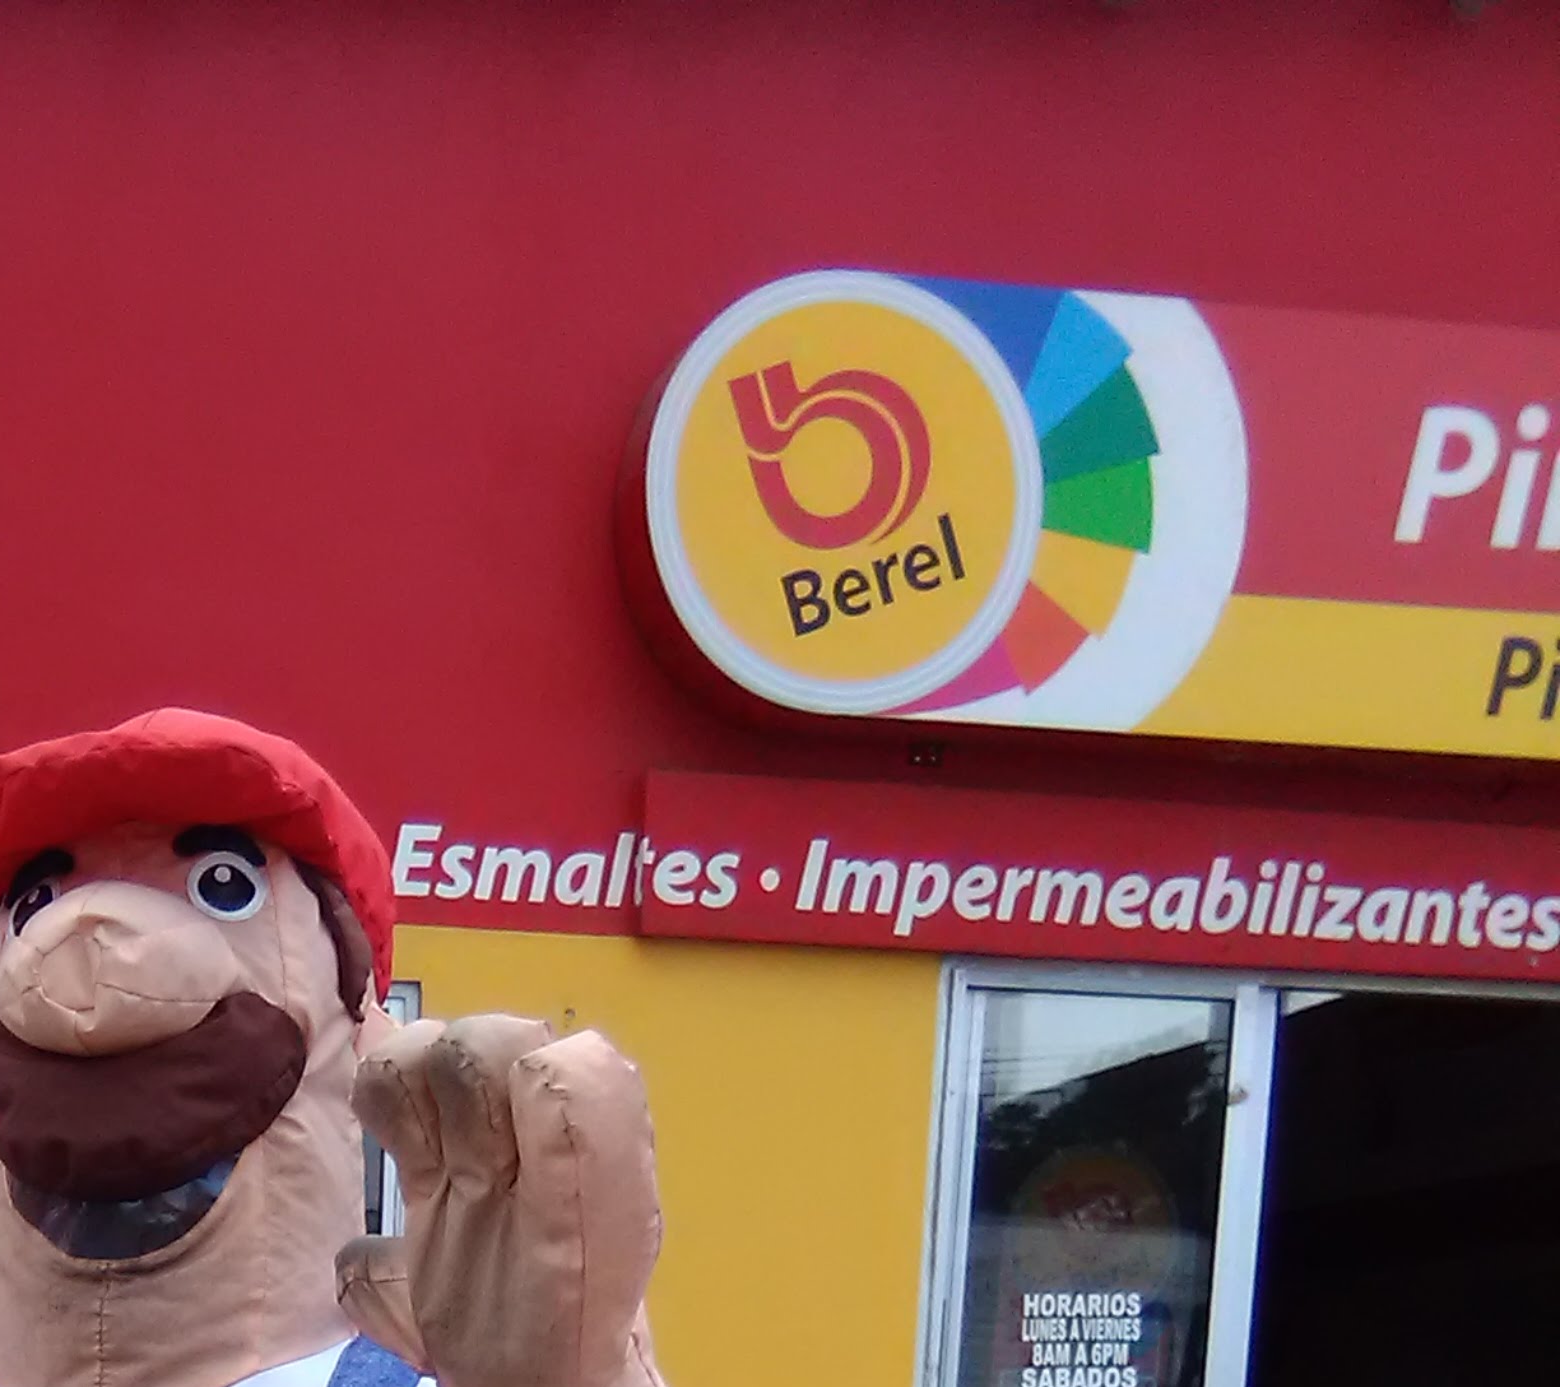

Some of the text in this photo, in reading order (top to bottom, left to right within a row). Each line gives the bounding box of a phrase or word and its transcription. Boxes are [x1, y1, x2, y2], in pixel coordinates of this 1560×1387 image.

[1394, 403, 1560, 550] Pi
[781, 513, 967, 637] Berel
[794, 837, 1560, 951] Impermeabilizantes
[1021, 1317, 1142, 1342] LUNES A VIERNES
[1022, 1292, 1142, 1317] HORARIOS
[1032, 1343, 1130, 1366] 8AM A 6PM
